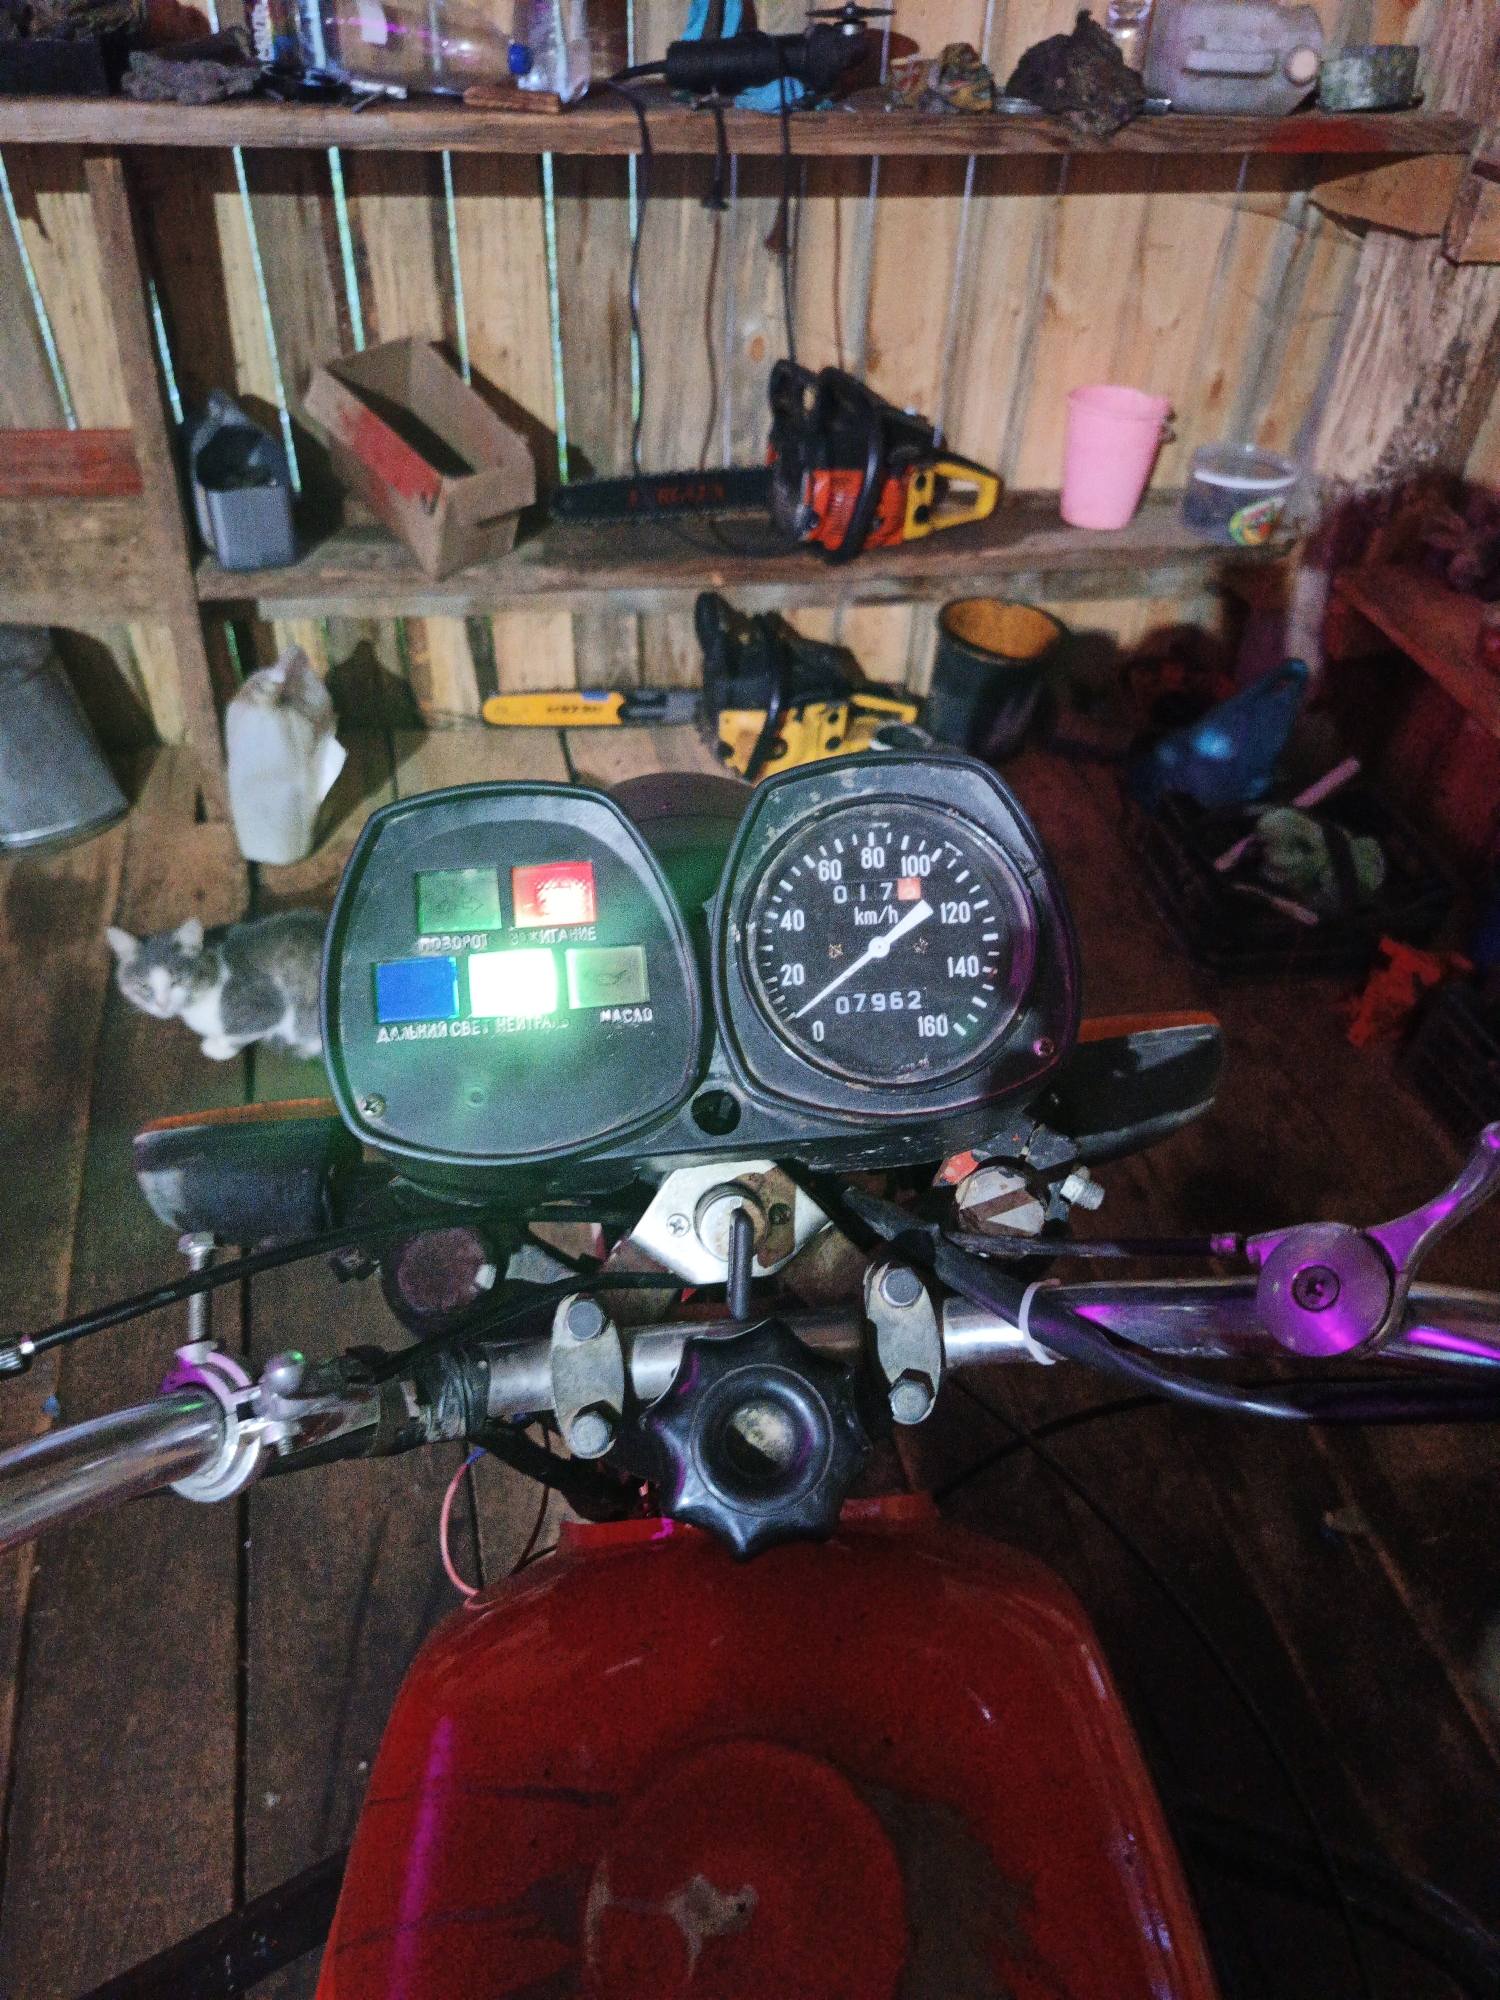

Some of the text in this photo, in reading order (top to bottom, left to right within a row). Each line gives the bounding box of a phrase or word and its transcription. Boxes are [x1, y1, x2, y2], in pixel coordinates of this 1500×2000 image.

[861, 847, 885, 869] 80
[901, 855, 931, 878] 100
[818, 859, 842, 881] 60
[780, 909, 805, 931] 40
[854, 904, 899, 925] km/h
[940, 901, 971, 924] 120
[780, 964, 805, 987] 20
[947, 955, 980, 978] 140
[835, 990, 922, 1015] 07962
[495, 1016, 570, 1035] НЕЙТРАЬ
[600, 1007, 653, 1024] МАСЛО
[917, 1015, 949, 1037] 160
[812, 1020, 825, 1042] 0
